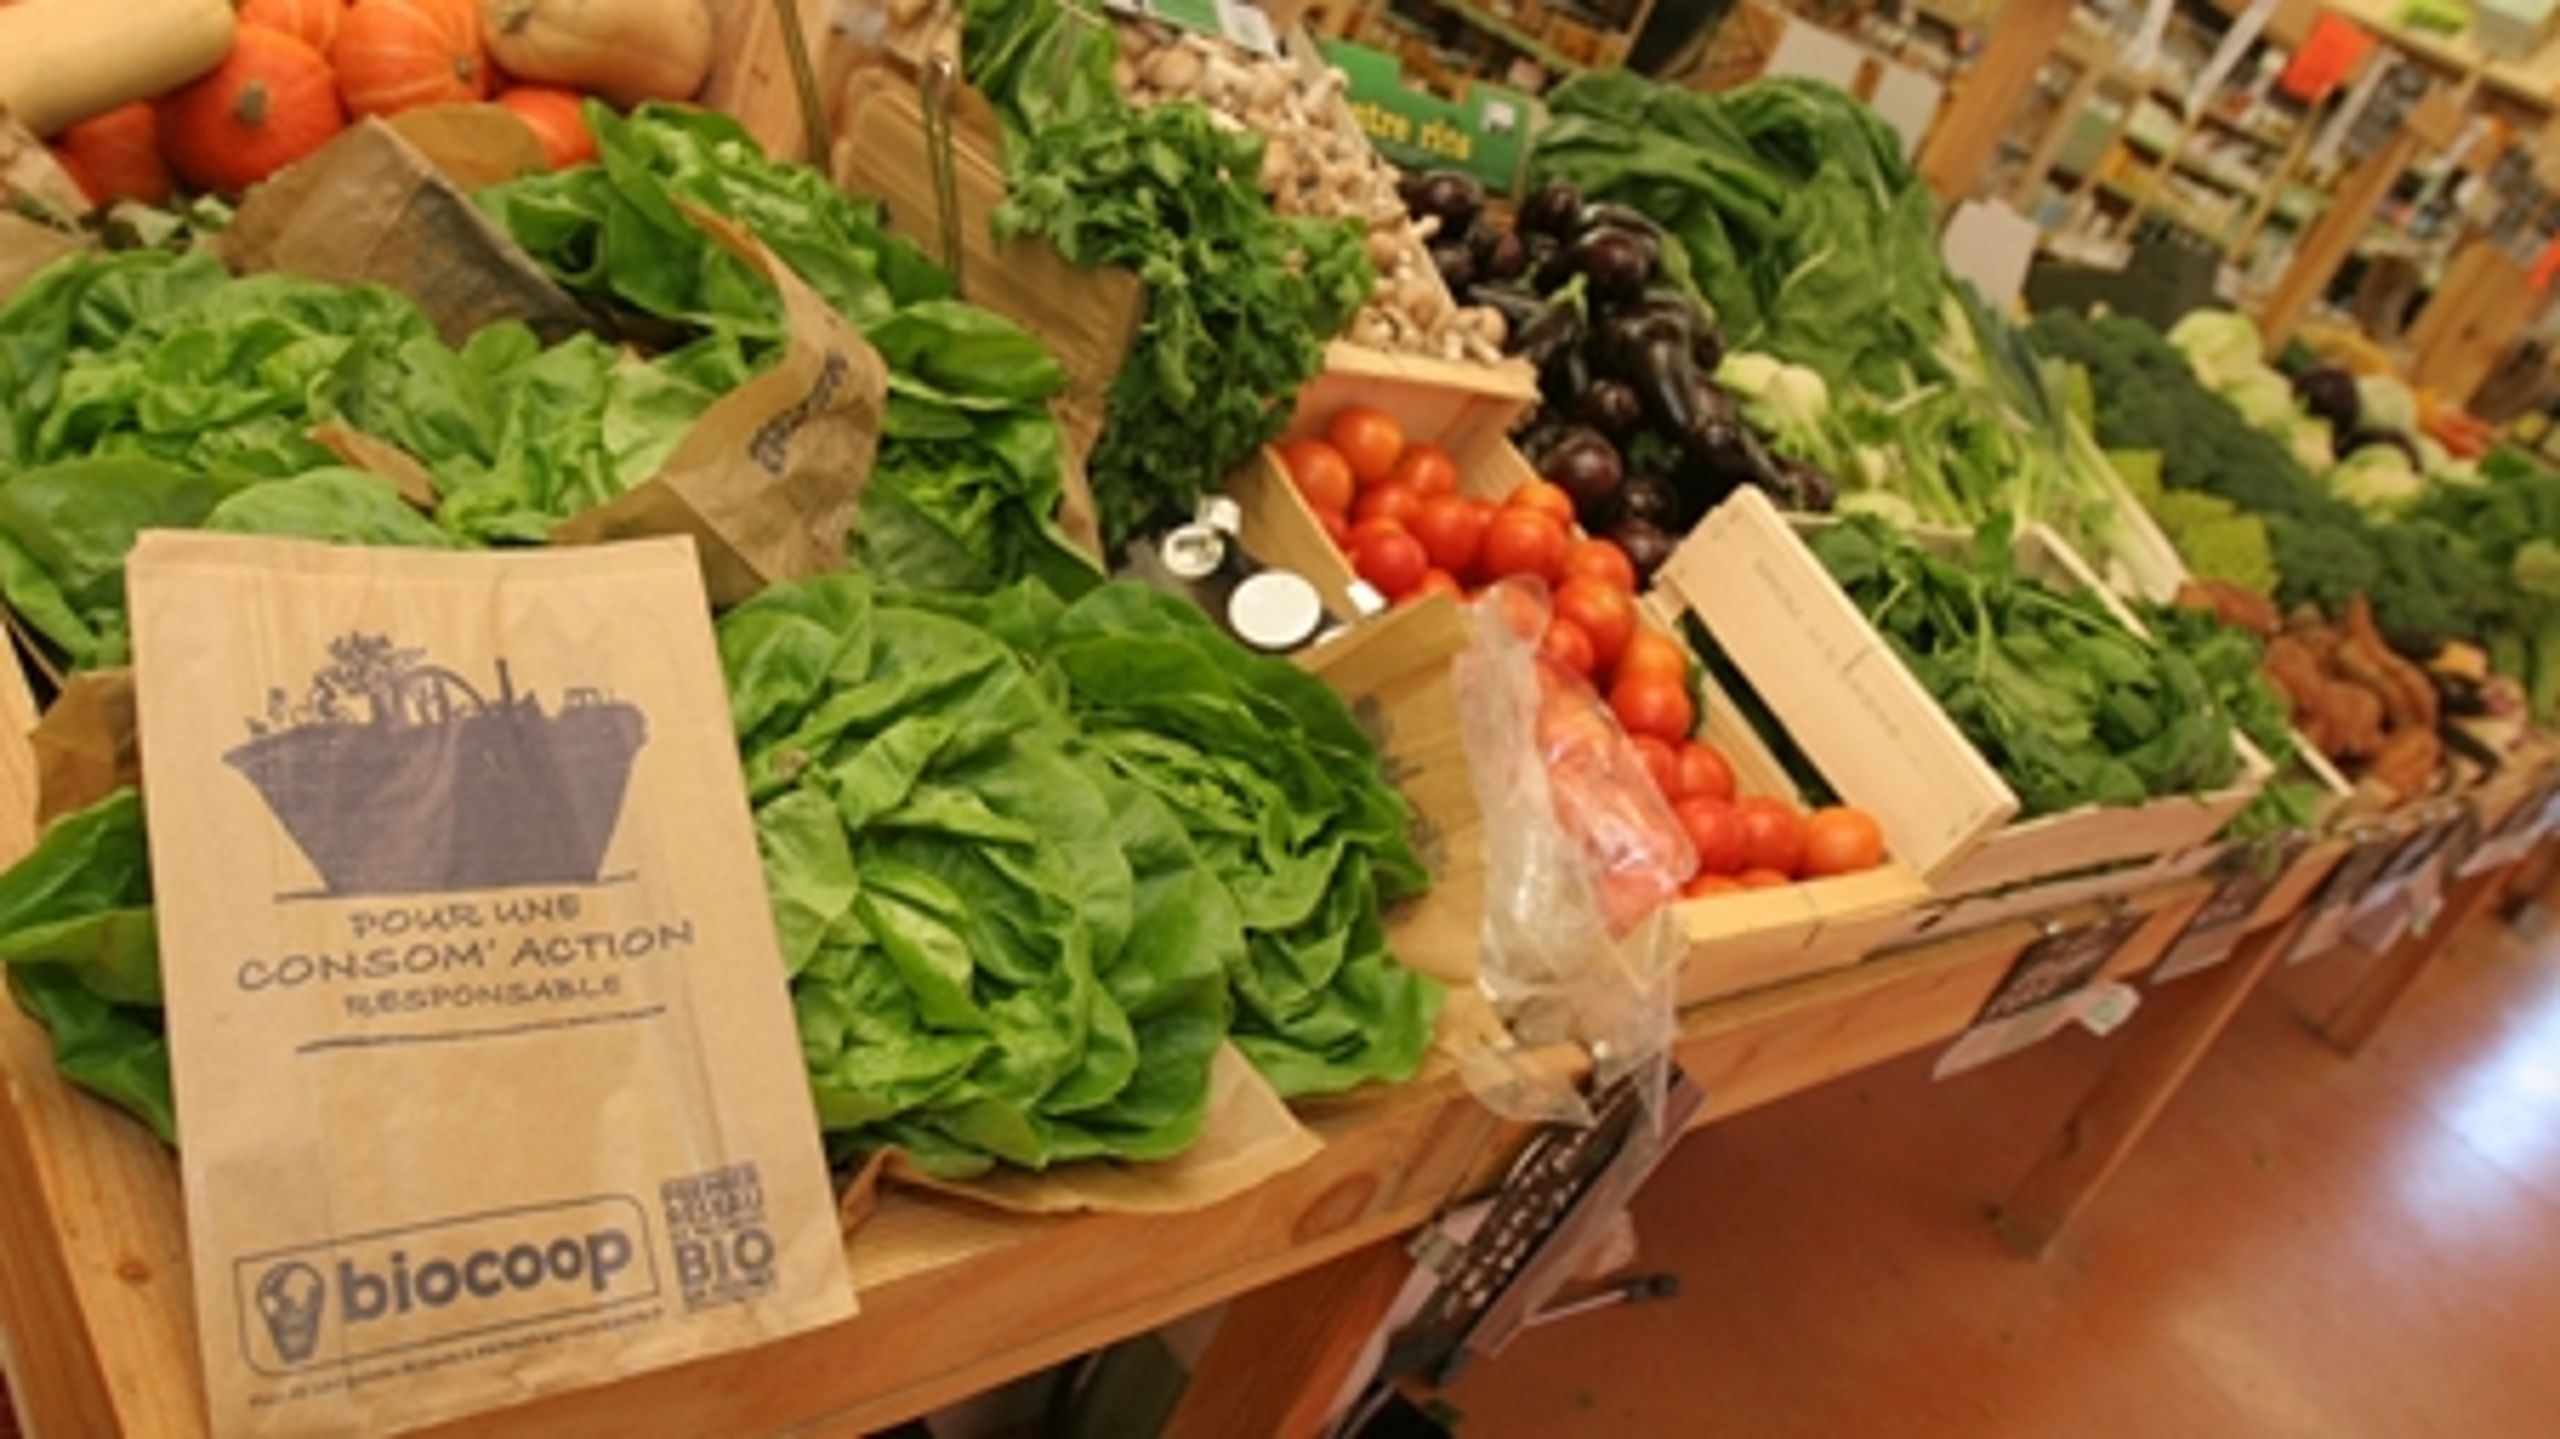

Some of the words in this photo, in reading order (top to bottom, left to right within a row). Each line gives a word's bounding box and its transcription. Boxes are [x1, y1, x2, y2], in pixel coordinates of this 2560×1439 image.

[348, 902, 483, 938] POUR
[494, 893, 581, 926] UNE
[236, 937, 497, 991] CONSOM'
[510, 919, 695, 969] ACTION
[343, 974, 622, 1017] RESPONSABLE
[337, 1229, 633, 1323] biocoop
[675, 1227, 776, 1286] BIO
